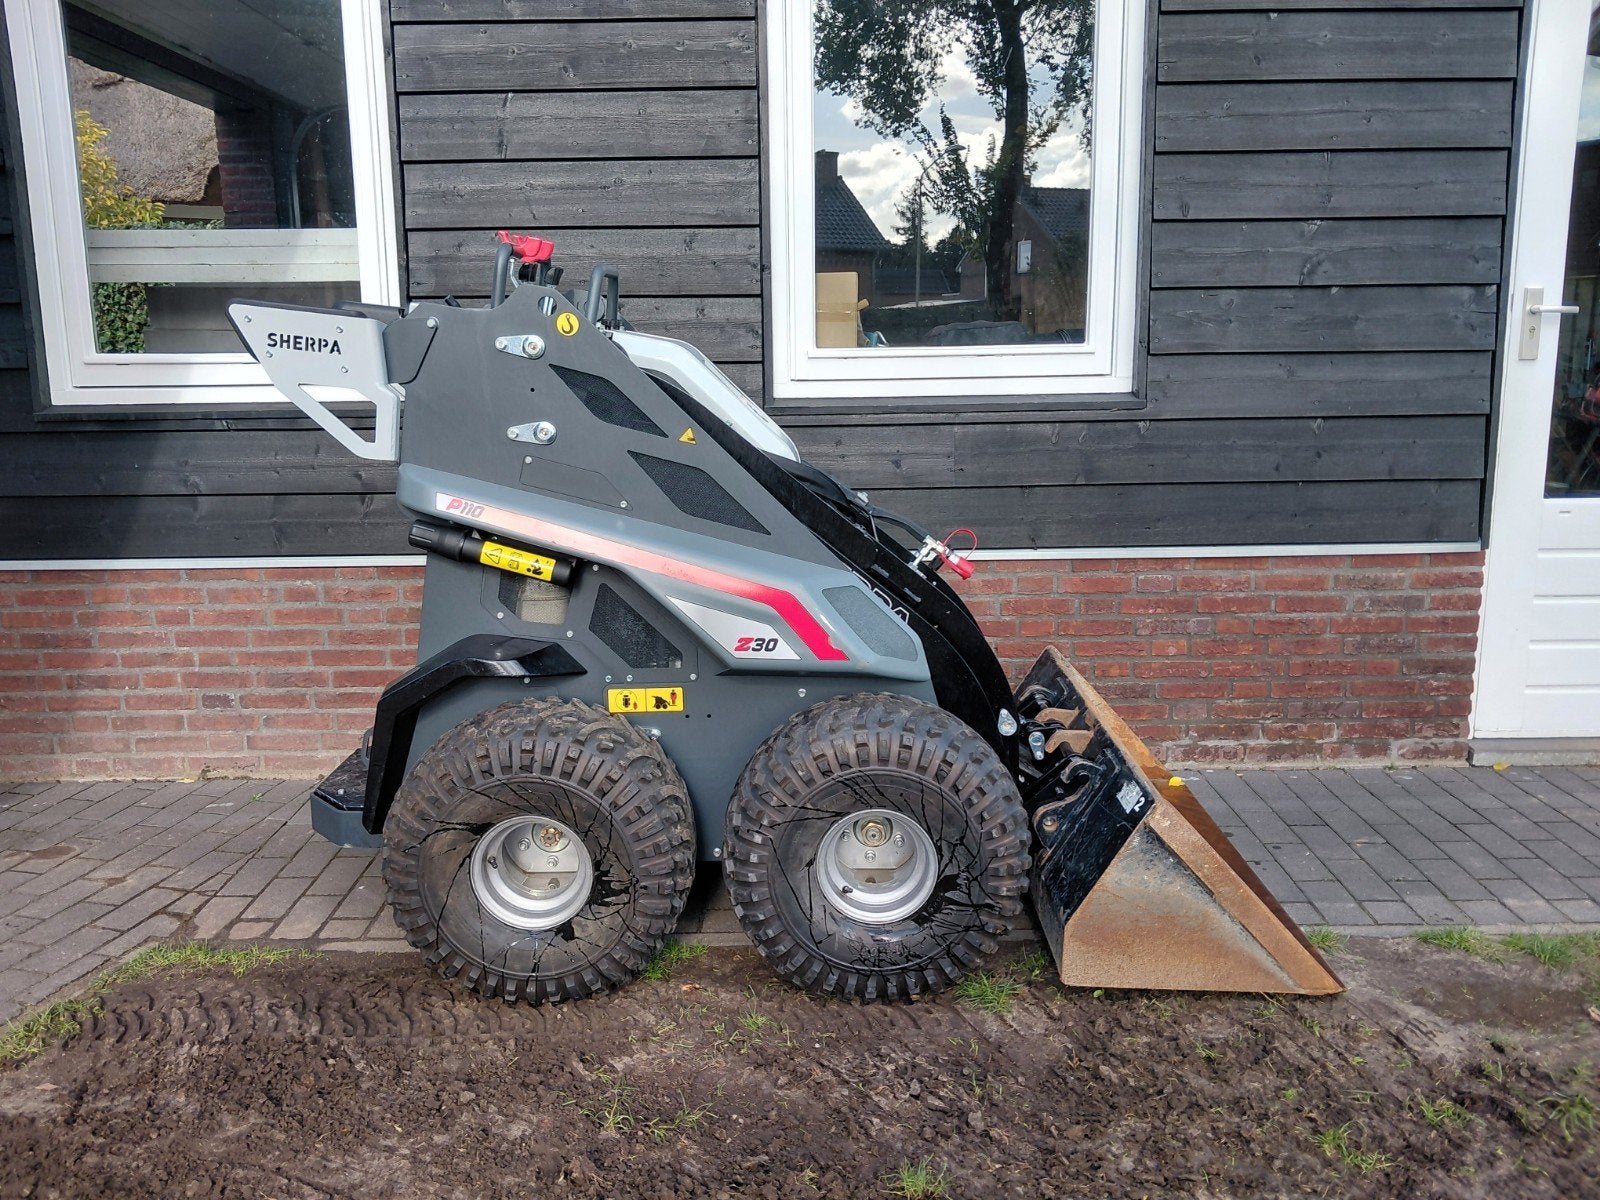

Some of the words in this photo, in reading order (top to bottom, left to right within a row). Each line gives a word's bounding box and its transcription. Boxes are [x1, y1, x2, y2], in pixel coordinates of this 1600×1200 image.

[267, 332, 342, 355] SHERPA
[446, 498, 486, 518] P110
[734, 637, 779, 652] Z30
